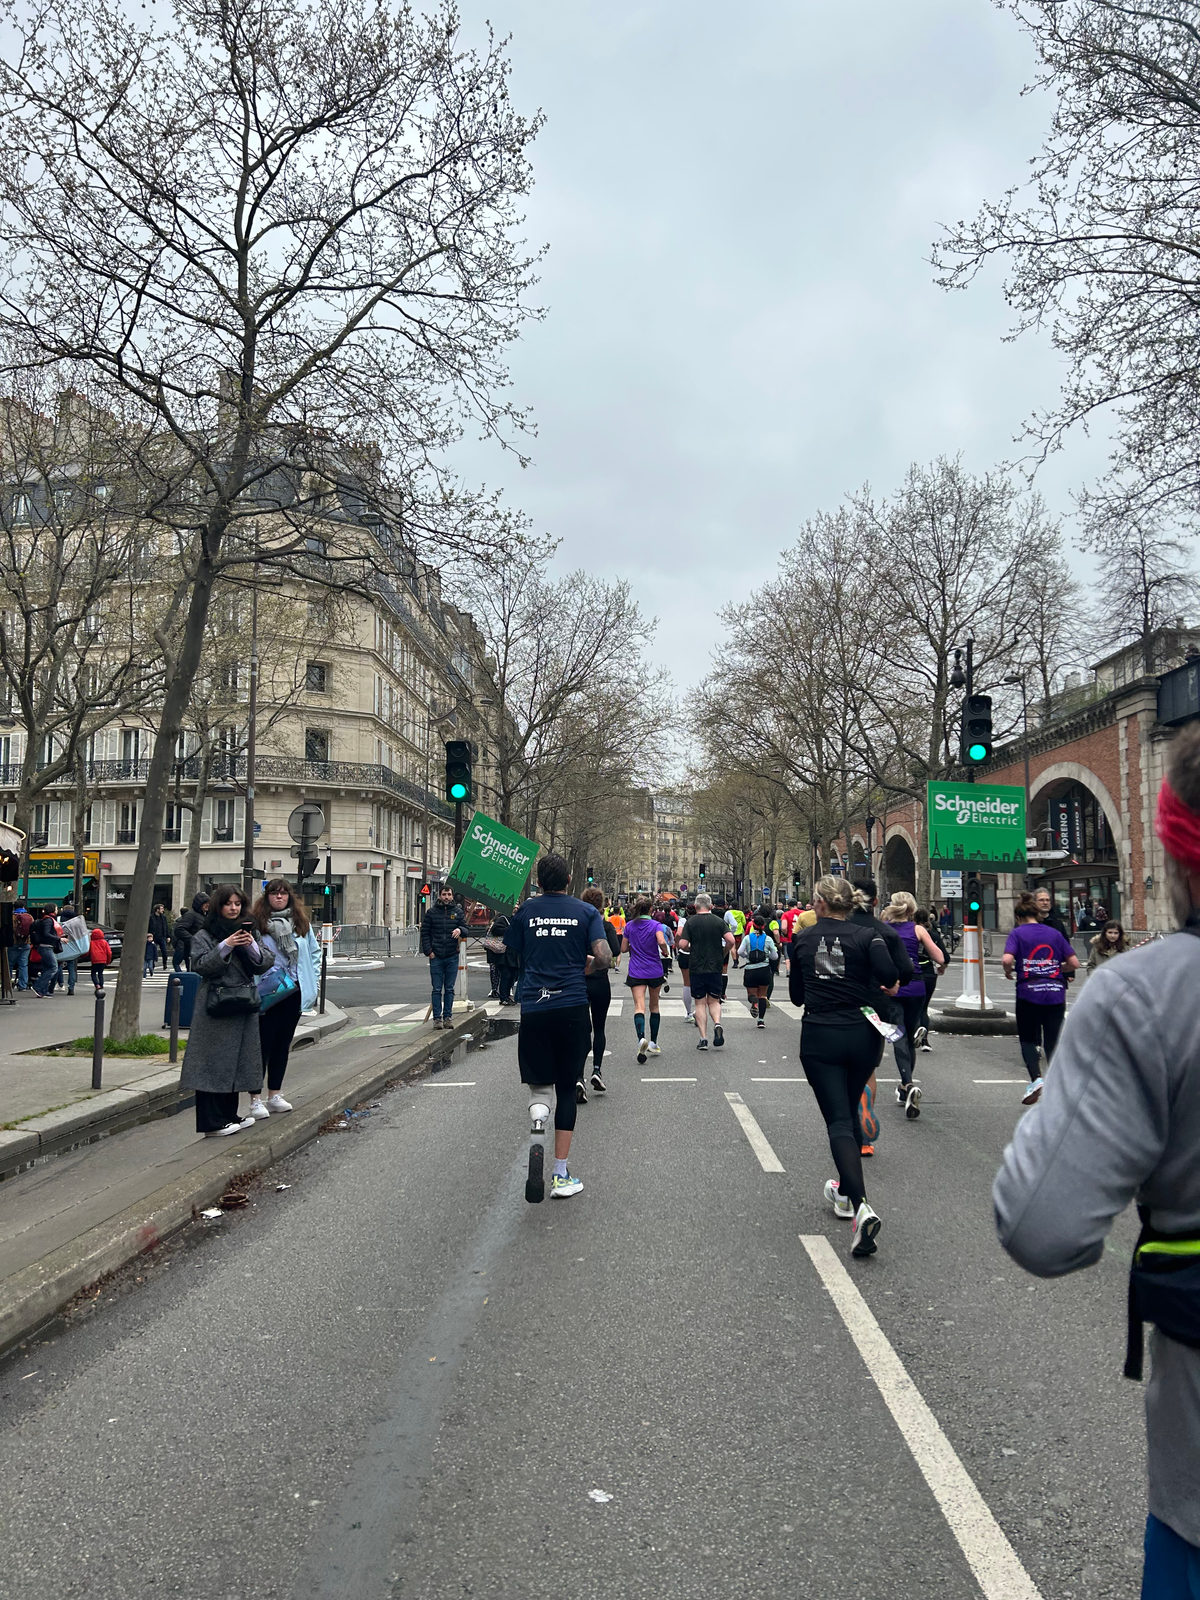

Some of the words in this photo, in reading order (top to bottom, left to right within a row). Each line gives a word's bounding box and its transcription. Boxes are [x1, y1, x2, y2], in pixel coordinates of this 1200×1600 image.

[935, 794, 1019, 814] Schneider
[972, 813, 1018, 825] Electric
[471, 825, 530, 865] Schneider
[491, 851, 524, 874] Electric
[529, 917, 578, 927] L'homme
[535, 927, 549, 937] de
[550, 926, 567, 936] fer
